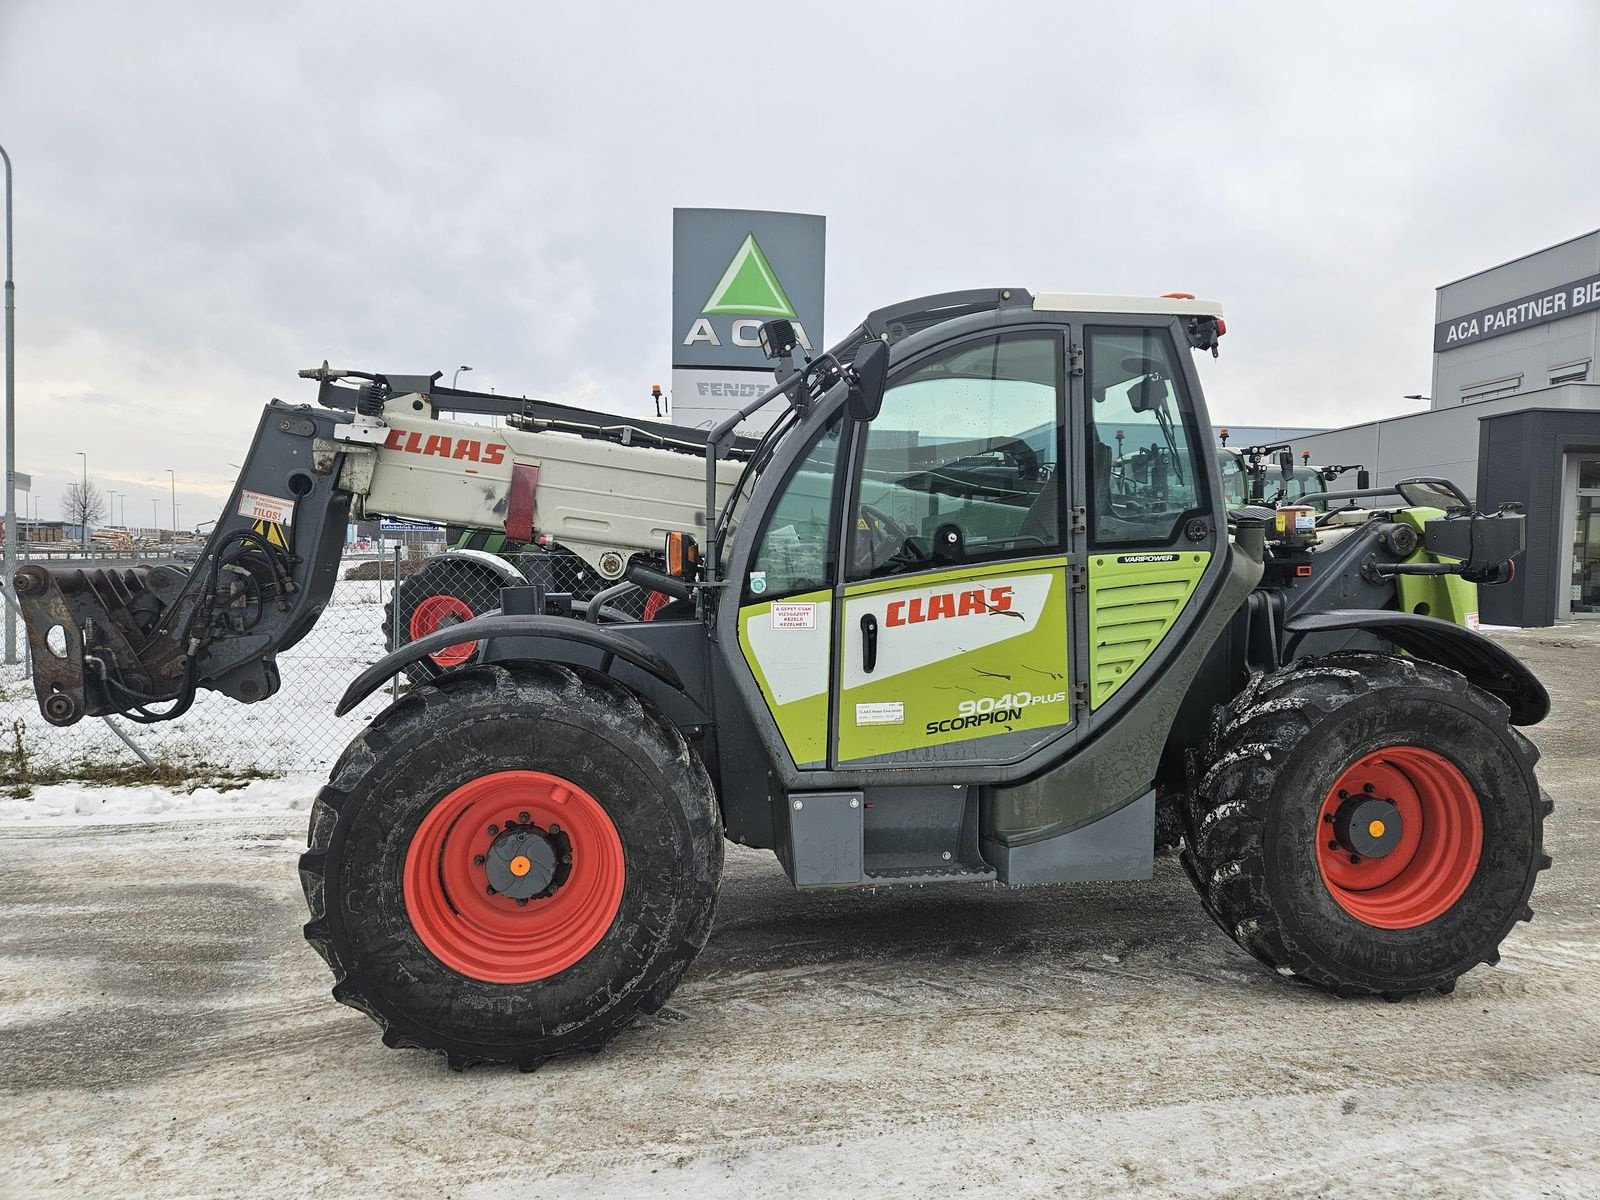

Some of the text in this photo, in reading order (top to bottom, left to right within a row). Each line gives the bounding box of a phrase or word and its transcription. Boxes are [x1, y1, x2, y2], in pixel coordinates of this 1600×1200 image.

[1447, 319, 1480, 343] ACA
[1484, 292, 1567, 332] PARTNER
[696, 382, 770, 398] FENDT
[384, 429, 507, 465] CLAAS
[252, 506, 282, 521] TILOS!
[1124, 555, 1174, 563] VARIPOWER
[885, 586, 1012, 627] CLAAS
[958, 691, 1066, 717] 9040 PLUS
[926, 708, 1022, 735] SCORPION
